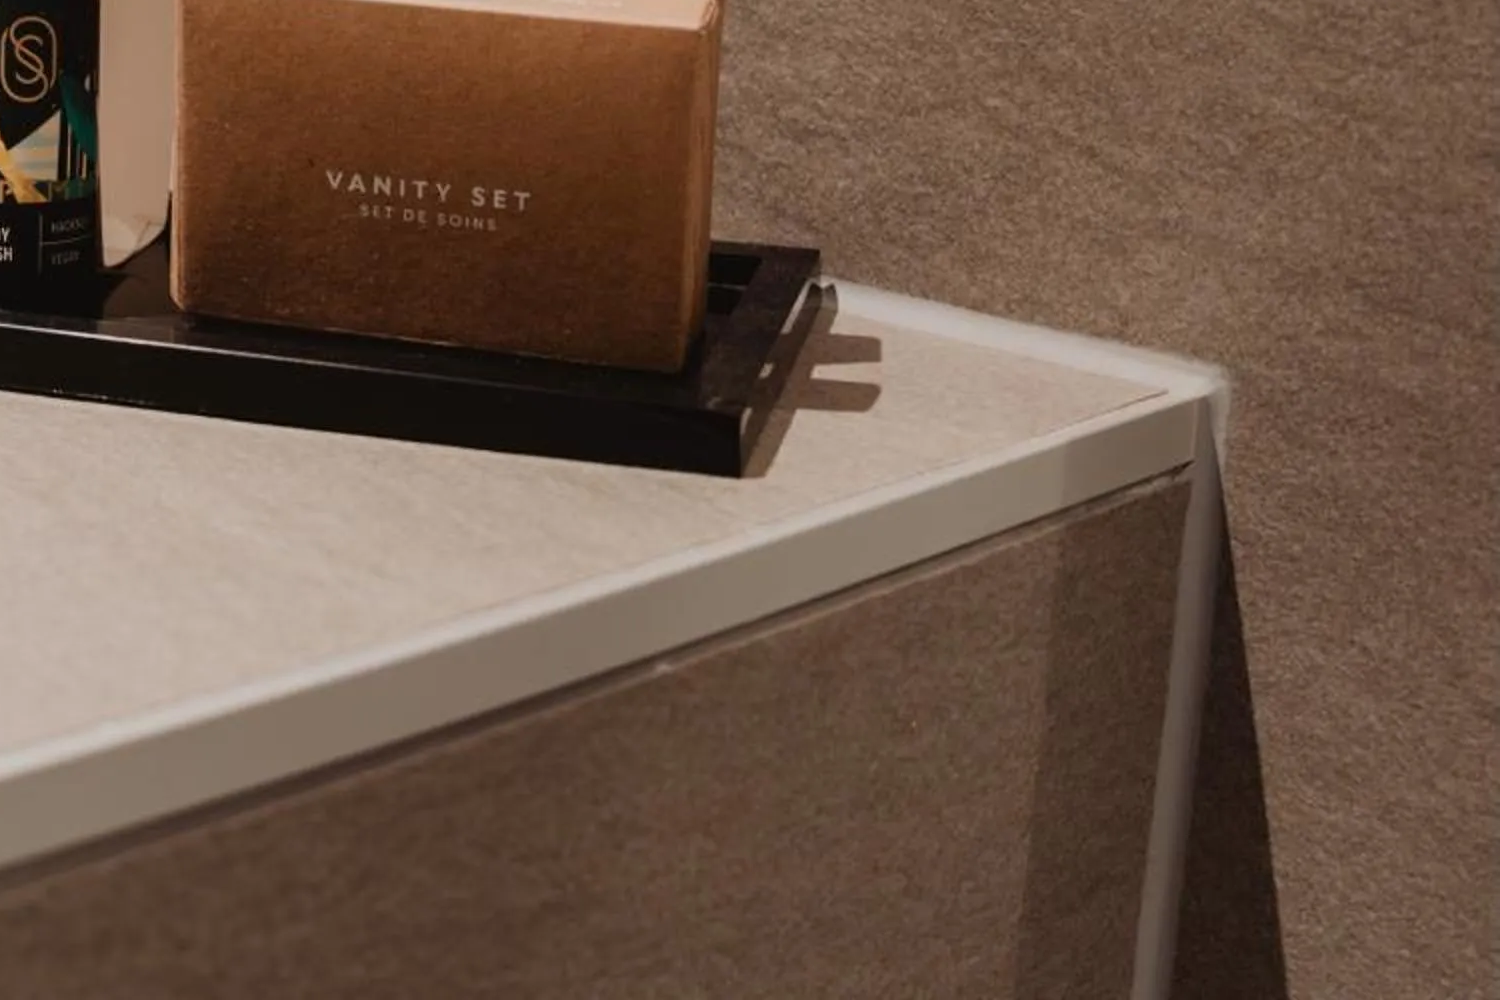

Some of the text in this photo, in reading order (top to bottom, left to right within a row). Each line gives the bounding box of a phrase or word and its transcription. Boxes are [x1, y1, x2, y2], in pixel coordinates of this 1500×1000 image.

[326, 169, 531, 212] VANITY SET
[358, 203, 498, 232] SET DE SOINS
